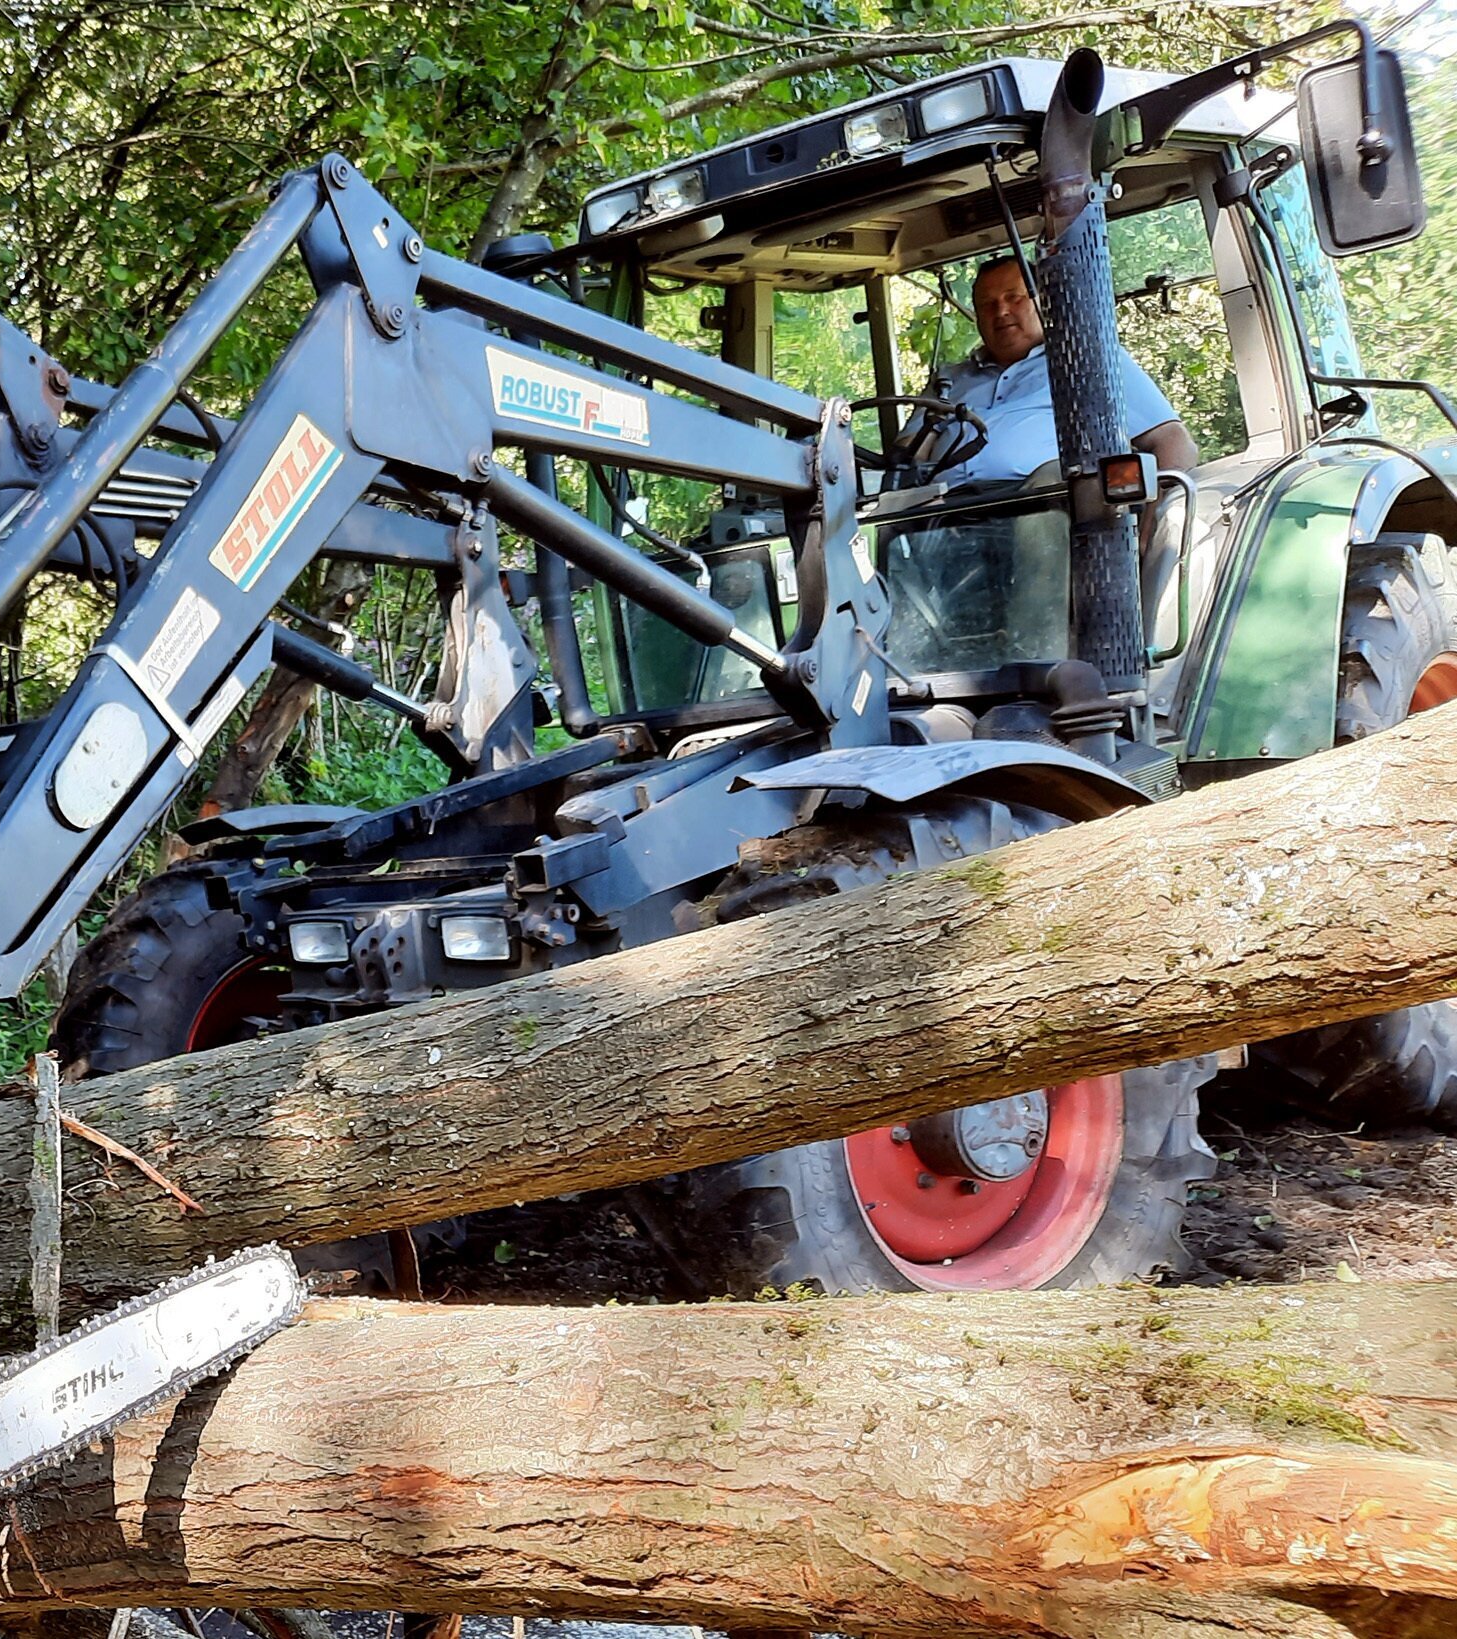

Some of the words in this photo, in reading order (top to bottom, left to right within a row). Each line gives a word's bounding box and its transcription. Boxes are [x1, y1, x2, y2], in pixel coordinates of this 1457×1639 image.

[500, 373, 582, 416] ROBUST
[583, 401, 600, 430] F
[221, 428, 327, 578] STOLL
[150, 645, 164, 662] Der
[161, 604, 192, 647] Aufenthalt
[52, 1360, 124, 1414] STIHL
